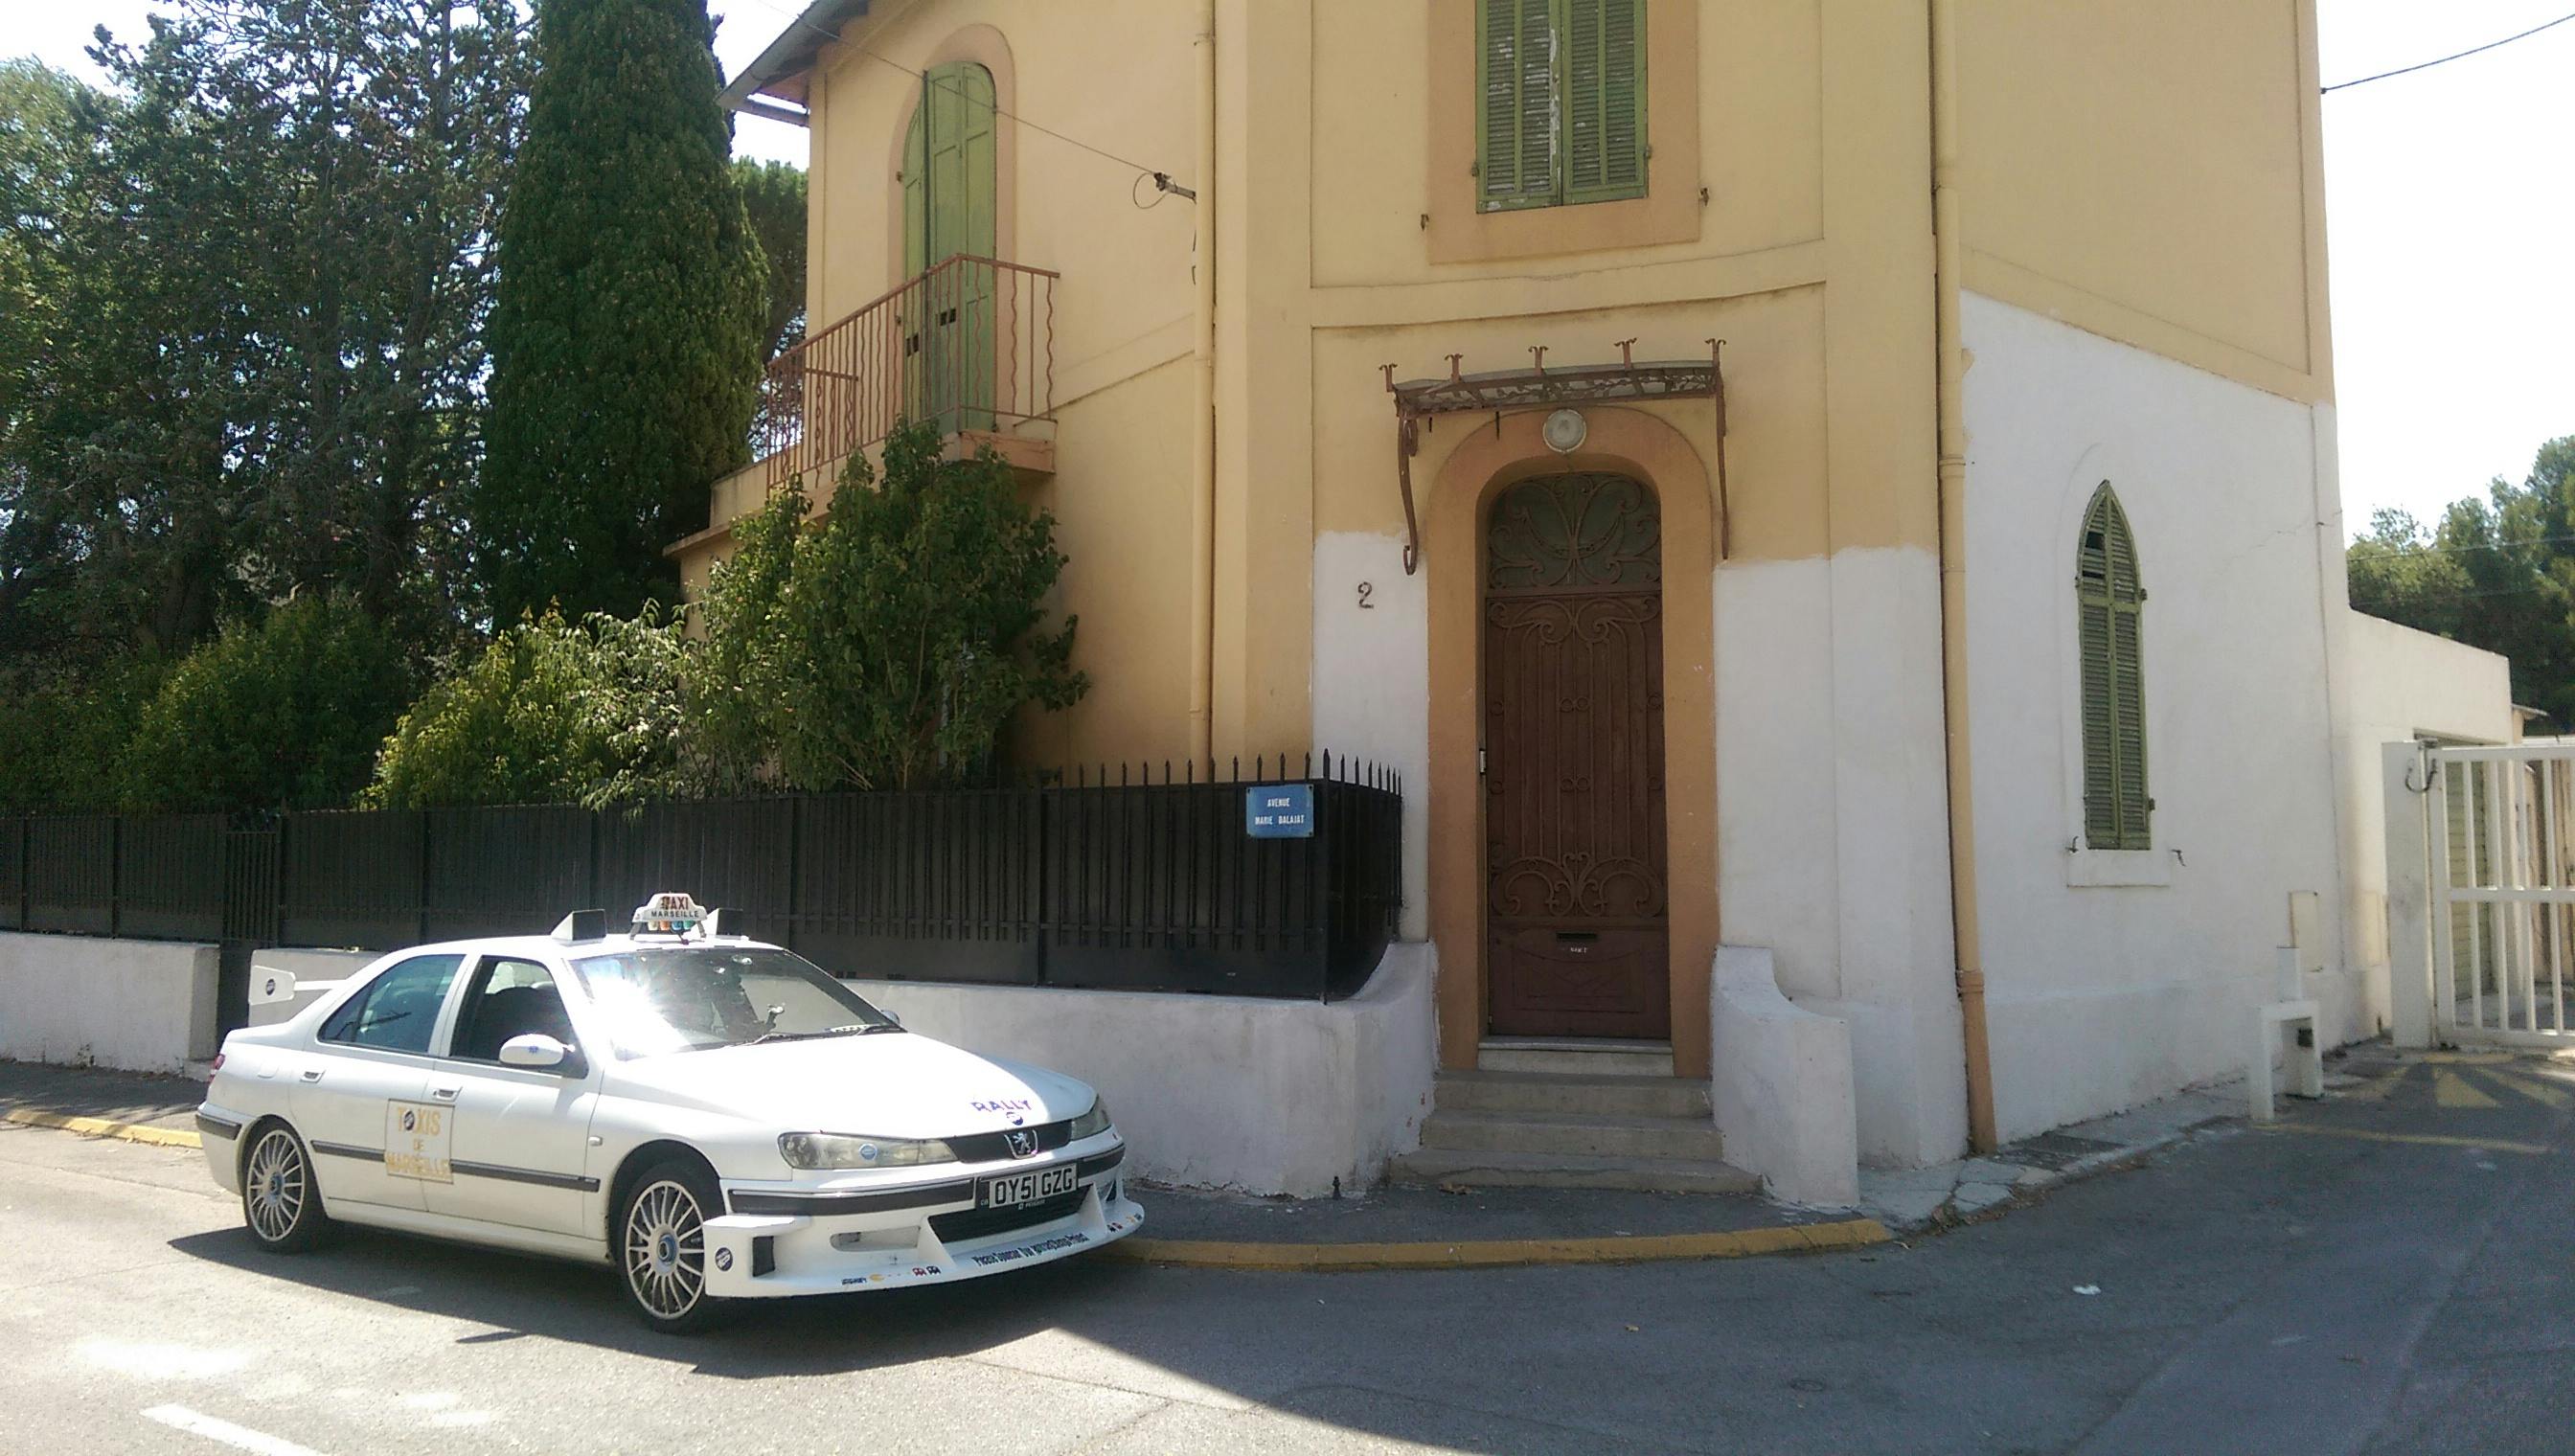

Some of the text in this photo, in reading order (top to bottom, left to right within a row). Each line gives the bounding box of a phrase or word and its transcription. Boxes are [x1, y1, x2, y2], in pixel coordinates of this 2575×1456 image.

[1358, 581, 1374, 608] 2
[1267, 797, 1290, 807] AVENUE
[1255, 816, 1273, 825] MARIE
[661, 896, 689, 910] TAXI
[970, 1100, 1032, 1112] RALLY
[398, 1106, 441, 1136] TXIS
[995, 1168, 1072, 1205] OY51 GZG
